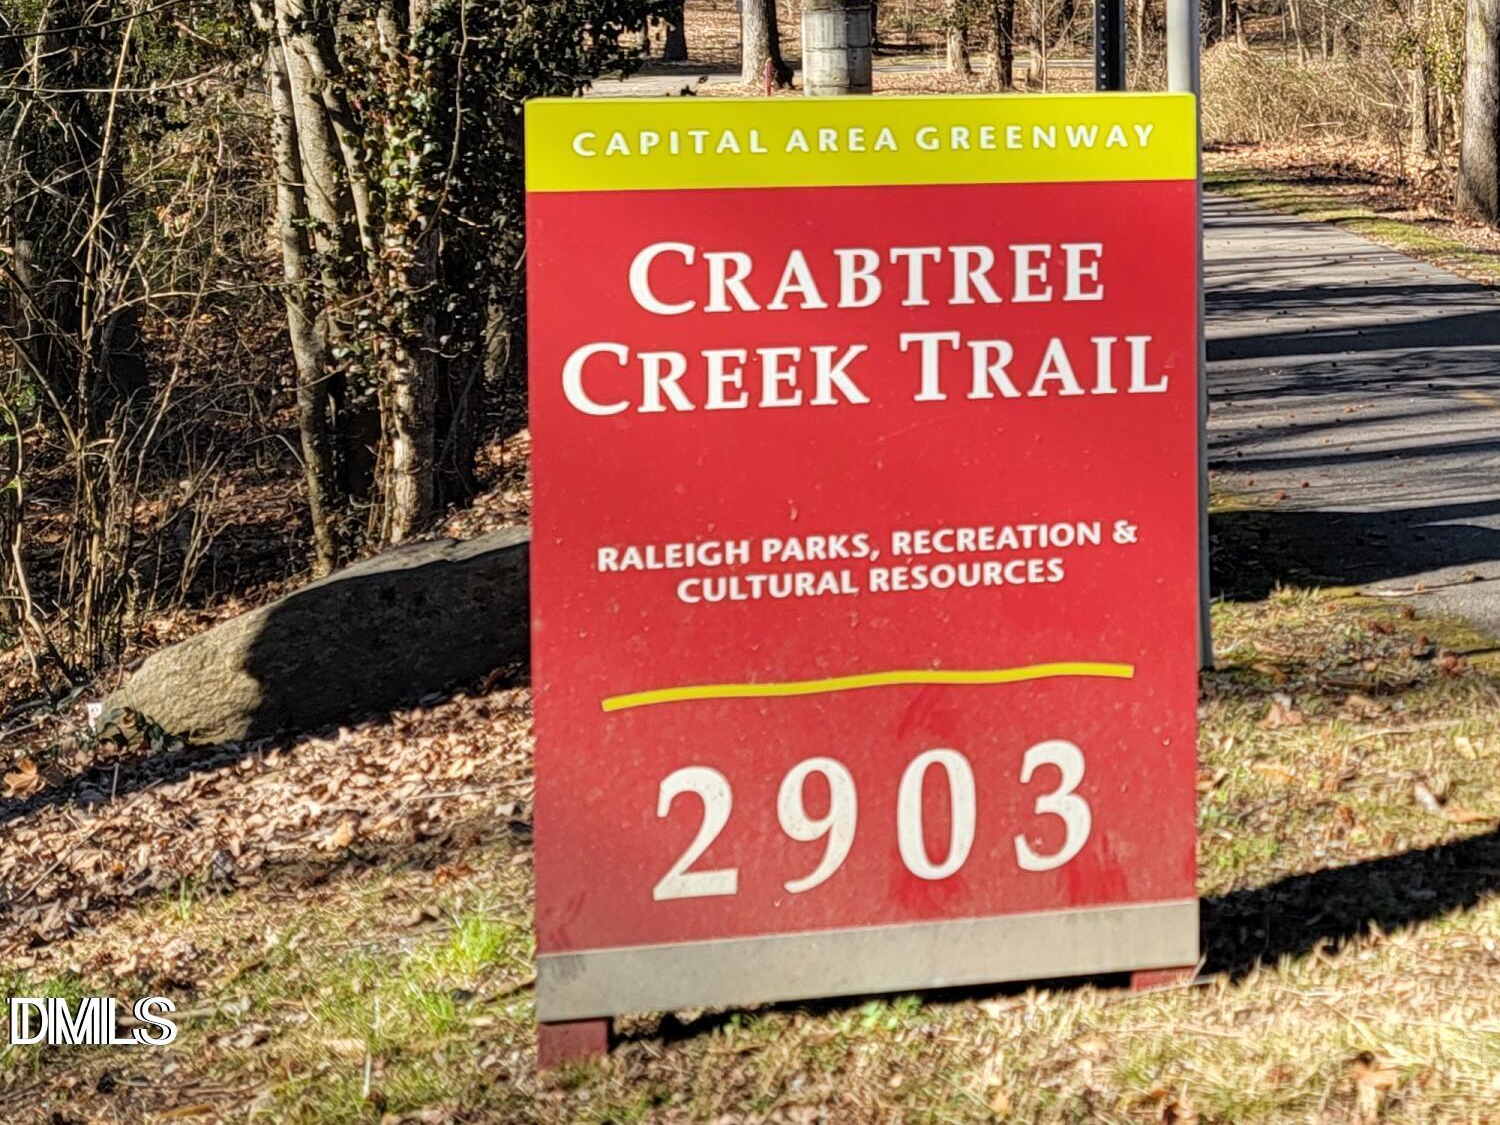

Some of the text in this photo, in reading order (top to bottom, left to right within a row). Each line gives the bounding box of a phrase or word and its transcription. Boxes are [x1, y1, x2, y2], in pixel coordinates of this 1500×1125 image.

[573, 123, 1155, 157] CAPITAL AREA GREENWAY
[628, 241, 1104, 316] CRABTREE
[561, 331, 1168, 416] CREEK TRAIL
[597, 520, 1138, 573] RALEIGH PARKS, RECREATION &
[677, 558, 1064, 604] CULTURAL RESOURCES
[652, 739, 1092, 901] 2903
